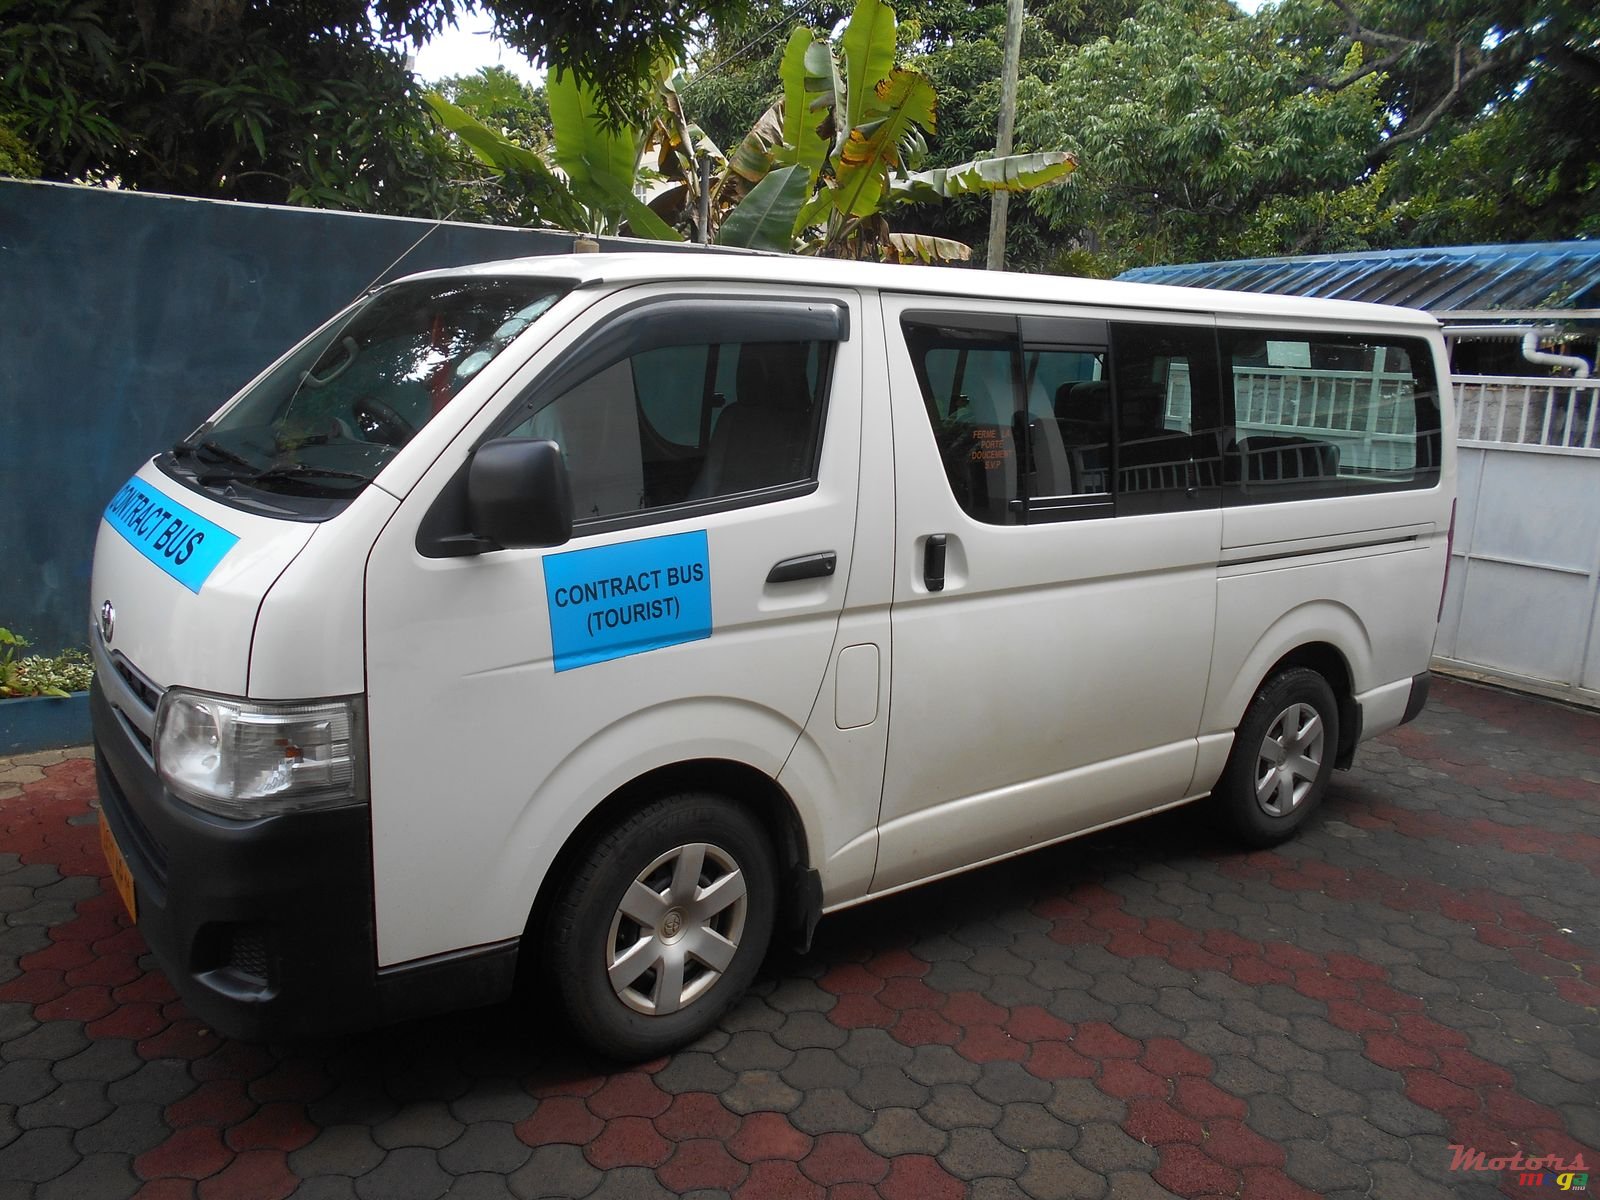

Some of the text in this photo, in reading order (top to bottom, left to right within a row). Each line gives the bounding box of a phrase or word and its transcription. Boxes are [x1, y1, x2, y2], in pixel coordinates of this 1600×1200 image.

[972, 430, 996, 439] FERME
[980, 440, 1004, 449] PORTE
[108, 484, 204, 566] CONTRACT BUS
[555, 562, 704, 608] CONTRACT BUS
[587, 594, 680, 637] (TOURIST)
